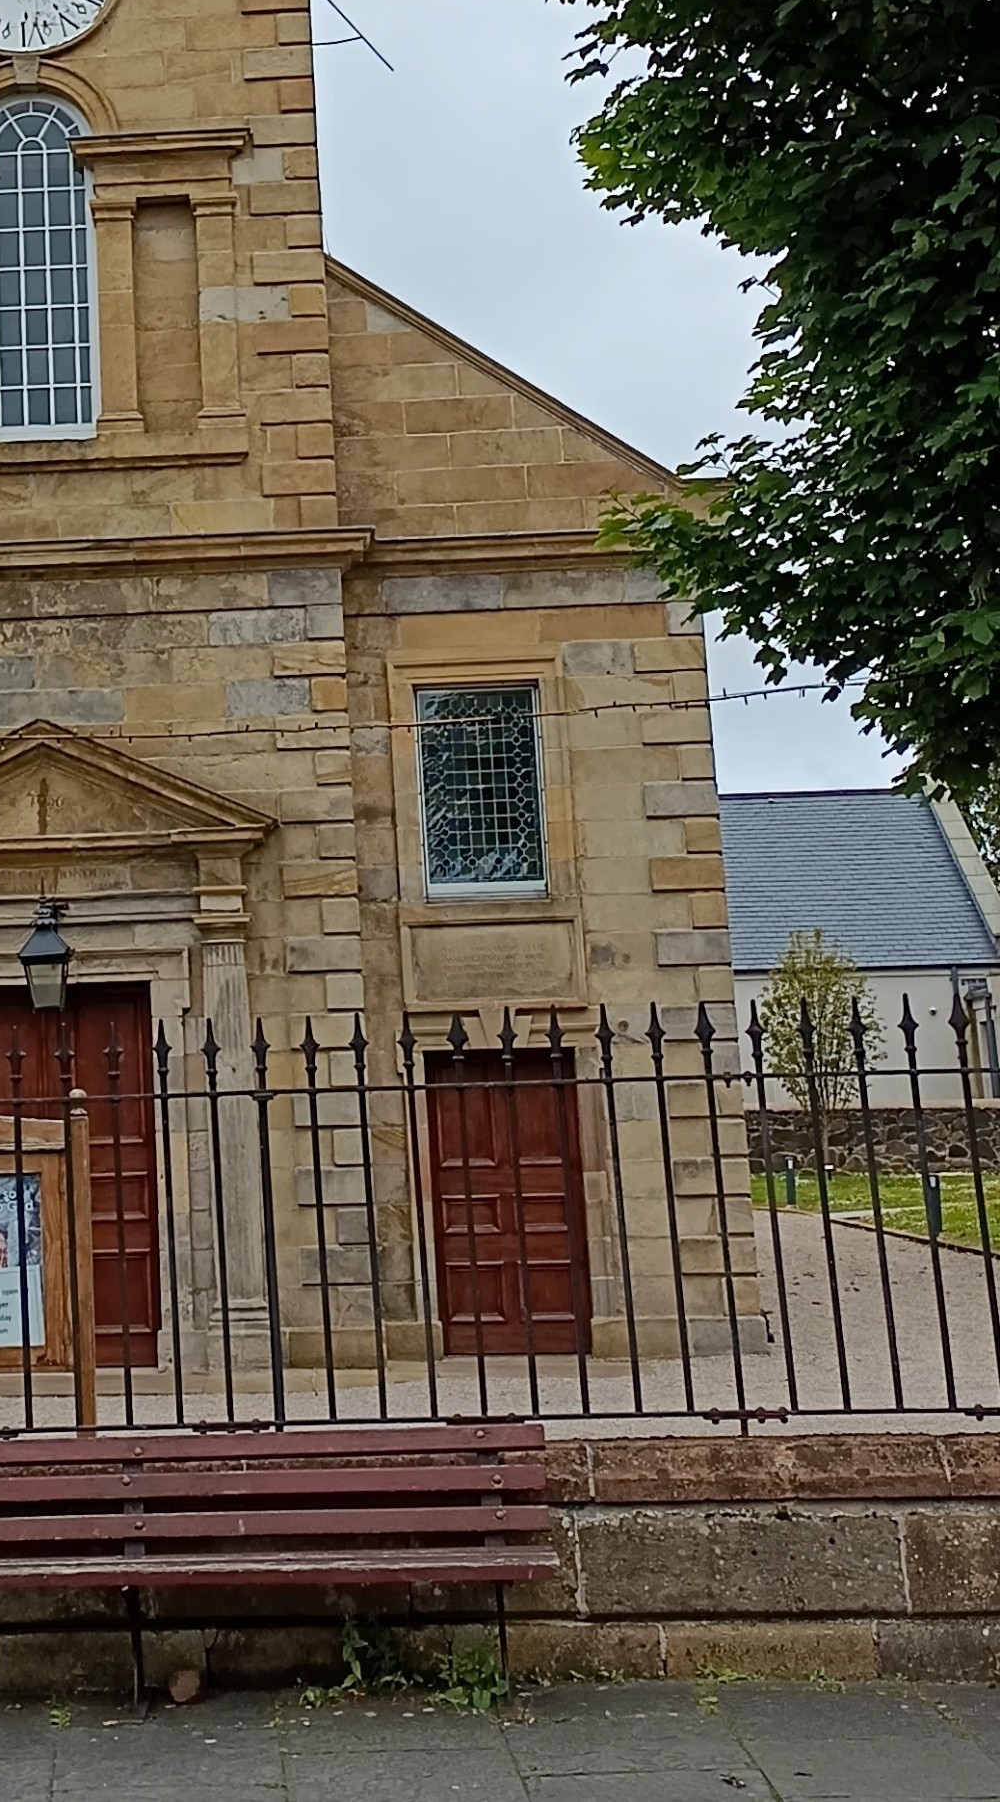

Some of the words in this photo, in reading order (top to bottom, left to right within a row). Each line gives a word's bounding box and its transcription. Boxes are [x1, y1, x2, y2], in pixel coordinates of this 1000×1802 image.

[20, 17, 47, 48] VI
[57, 11, 80, 38] V
[3, 1190, 16, 1199] so
[7, 1200, 33, 1211] Gd
